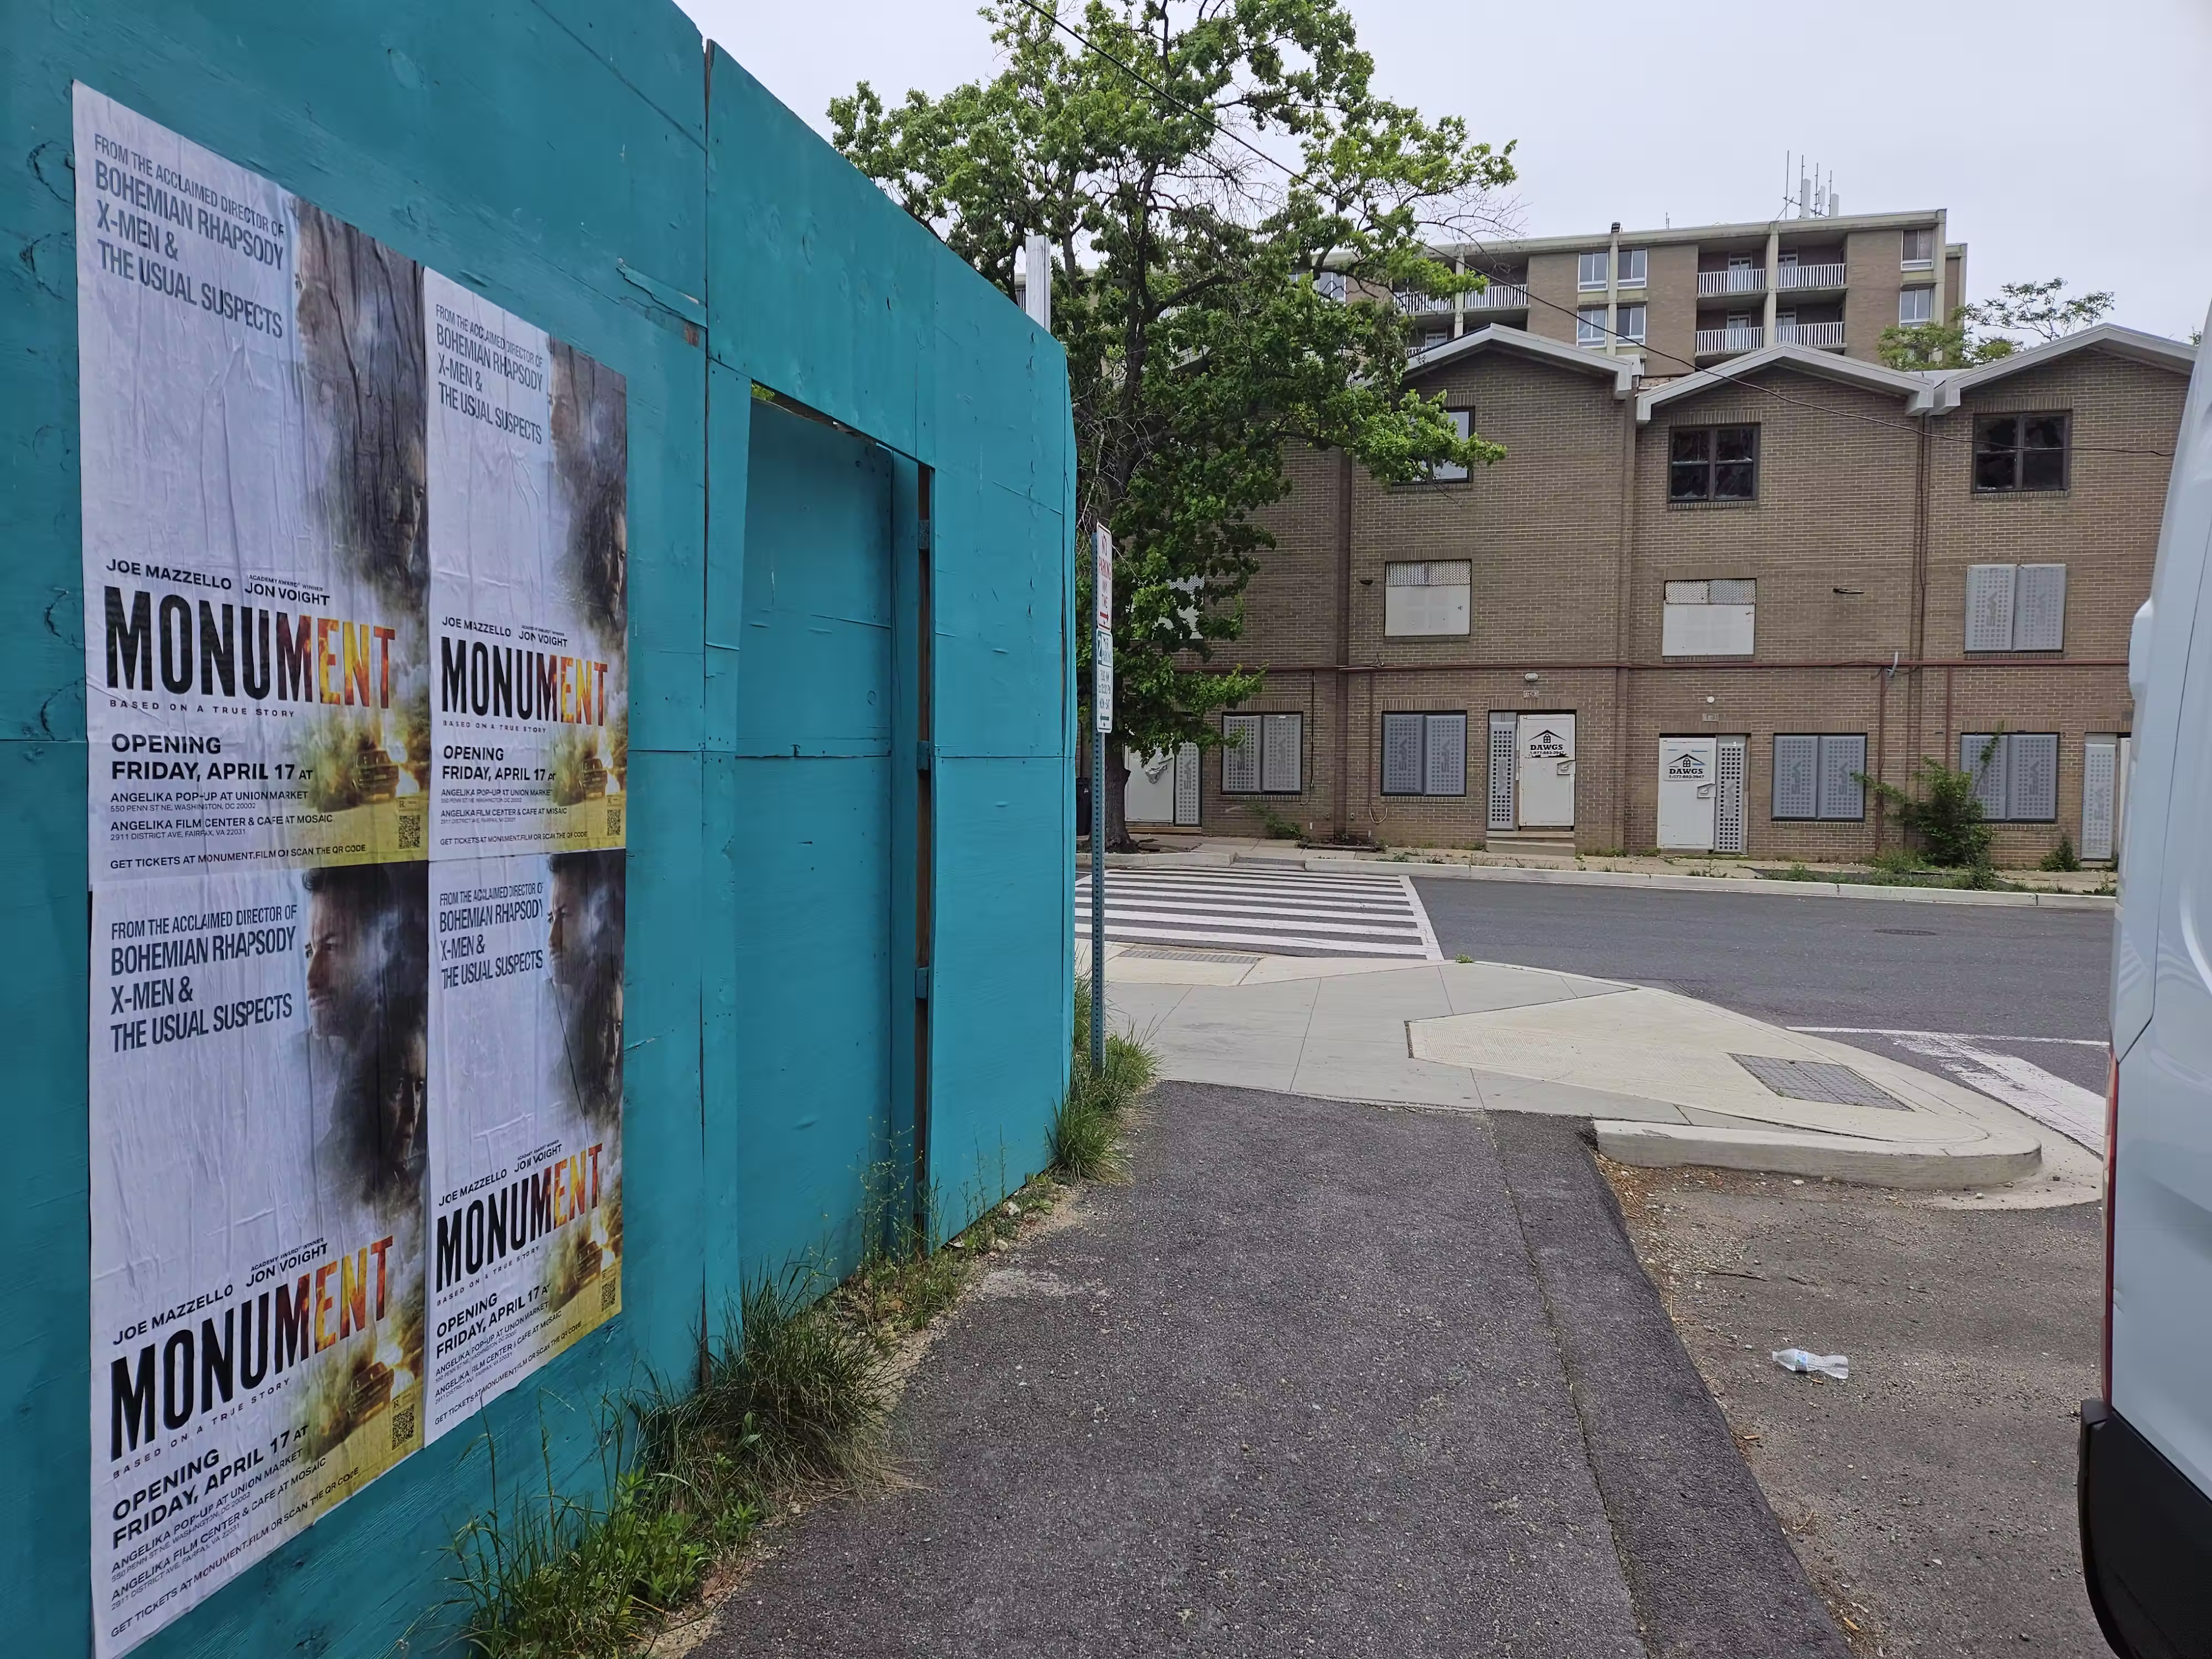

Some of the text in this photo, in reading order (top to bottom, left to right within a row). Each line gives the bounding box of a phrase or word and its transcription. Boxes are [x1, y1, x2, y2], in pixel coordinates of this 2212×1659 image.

[95, 133, 283, 239] FROM THE ACCLAIMED DIRECTOR OF
[96, 159, 283, 270] BOHEMIAN RHAPSODY
[97, 199, 178, 262] X-MEN &
[97, 239, 282, 338] THE USUAL SUSPECTS
[437, 323, 542, 392] BOHEMIAN RHAPSODY
[439, 352, 482, 393] X-MEN &
[439, 382, 541, 445] THE USUAL SUSPECTS
[106, 558, 330, 606] JOE MAZZELLO JON VOIGHT
[249, 575, 277, 583] ACADEMY
[105, 586, 396, 708] MONUMENT
[442, 617, 461, 628] JOE
[538, 634, 567, 647] VOIGHT
[441, 637, 607, 726] MONUMENT
[110, 700, 159, 709] BASED
[213, 706, 247, 714] TRUE
[256, 708, 294, 717] STORY
[112, 734, 221, 754] OPENING
[444, 745, 503, 761] OPENING
[112, 761, 313, 782] FRIDAY, APRIL 17 AT
[443, 766, 545, 781] FRIDAY, APRIL 17
[111, 791, 308, 802] ANGELIKA POP-UP AT UNION MARKET
[111, 820, 173, 831] ANGELIKA
[176, 818, 201, 828] FILM
[205, 817, 245, 827] CENTER
[248, 817, 254, 826] &
[284, 816, 295, 825] AT
[298, 815, 332, 824] MOSAIC
[132, 831, 166, 839] DISTRICT
[111, 859, 133, 869] GET
[135, 857, 180, 867] TICKETS
[183, 855, 196, 864] AT
[199, 850, 275, 863] MONUMENT.FILM
[291, 848, 314, 856] SCAN
[112, 905, 297, 940] FROM THE ACCLAIMED DIRECTOR OF
[440, 905, 492, 932] BOHEMIAN
[112, 926, 296, 975] BOHEMIAN RHAPSODY
[441, 935, 485, 961] X-MEN &
[441, 950, 542, 989] THE USUAL SUSPECTS
[111, 976, 193, 1015] X-MEN &
[111, 993, 291, 1052] THE USUAL SUSPECTS
[439, 1191, 457, 1206] JOE
[460, 1169, 507, 1197] MAZZELLO
[534, 1144, 562, 1164] VOIGHT
[436, 1143, 602, 1293] MONUMENT
[113, 1243, 327, 1345] JOE MAZZELLO JON VOIGHT
[437, 1293, 497, 1337] OPENING
[437, 1286, 539, 1359] FRIDAY, APRIL 17
[111, 1235, 393, 1462] MONUMENT
[113, 1378, 289, 1479] BASED ON A TRUE STORY
[113, 1449, 218, 1520] OPENING
[113, 1424, 309, 1550] FRIDAY, APRIL 17 AT
[112, 1448, 302, 1573] ANGELIKA POP-UP AT UNION MARKET
